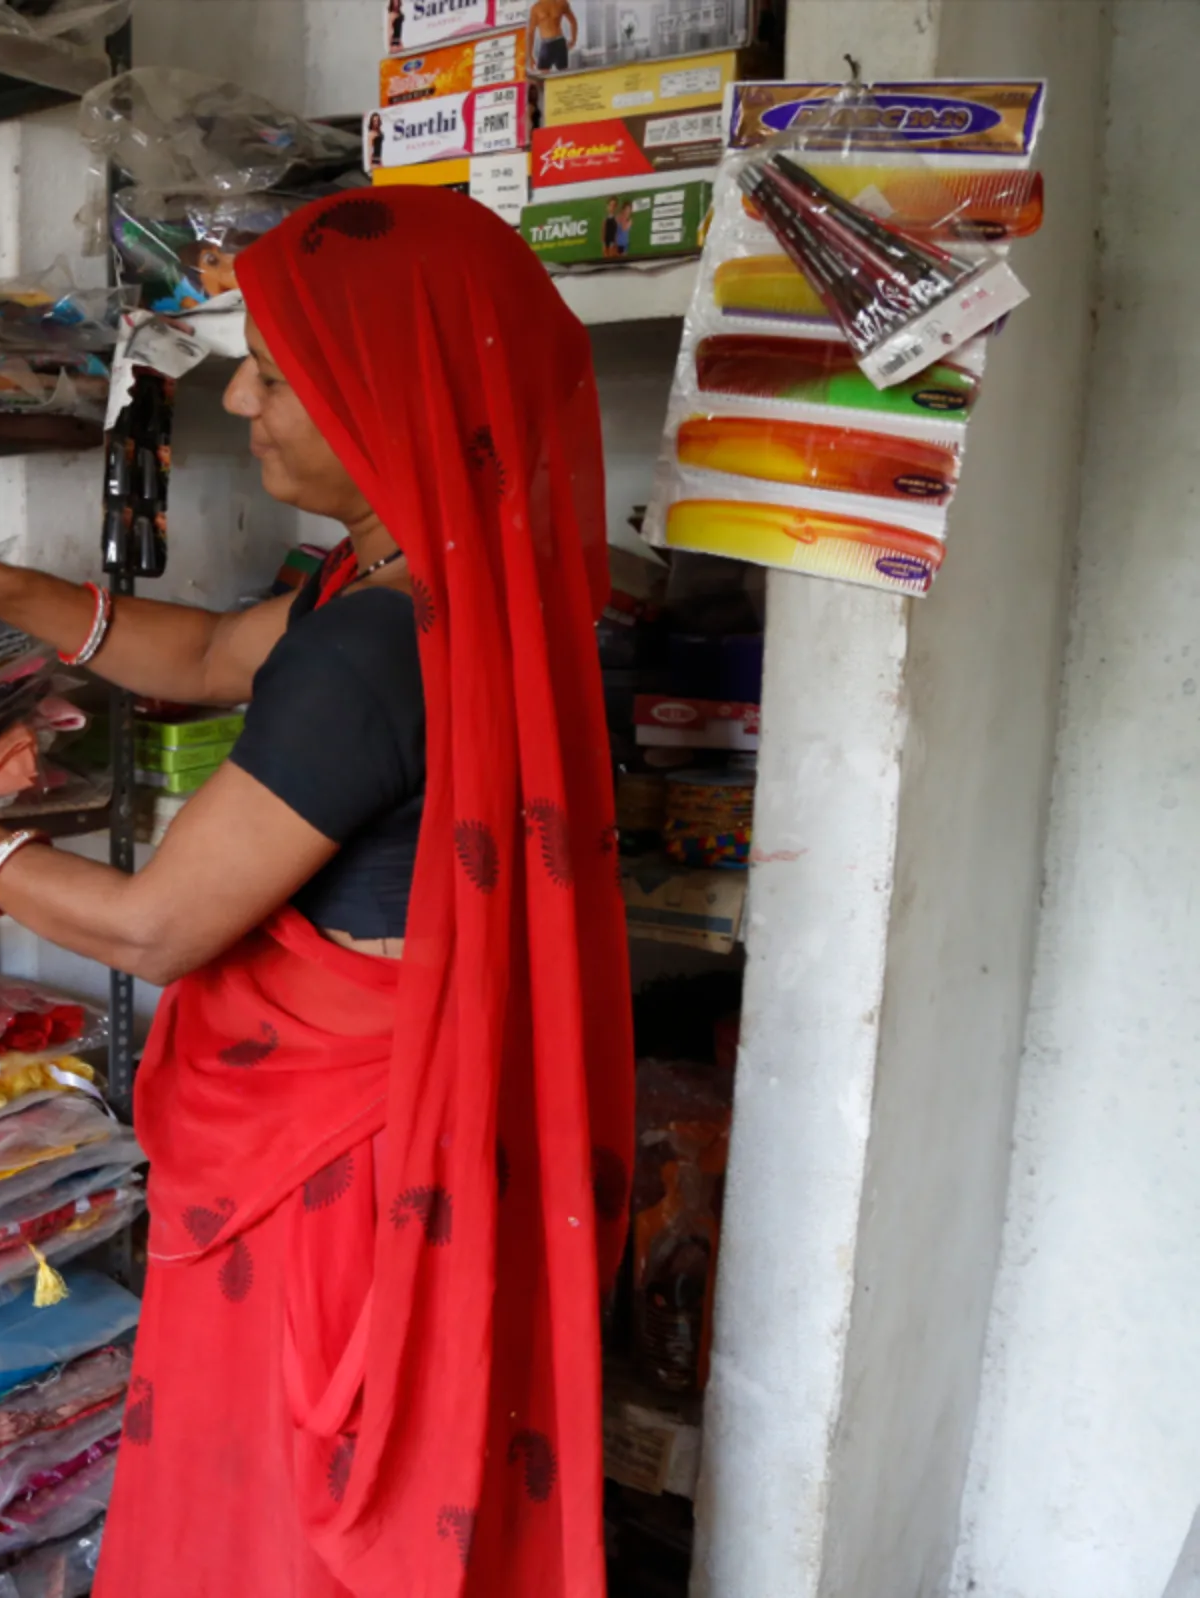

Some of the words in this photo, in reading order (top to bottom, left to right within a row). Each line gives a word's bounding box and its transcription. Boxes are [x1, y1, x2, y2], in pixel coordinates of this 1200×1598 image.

[413, 0, 478, 21] Sart
[393, 109, 457, 141] Sarthi
[484, 112, 509, 132] PRINT
